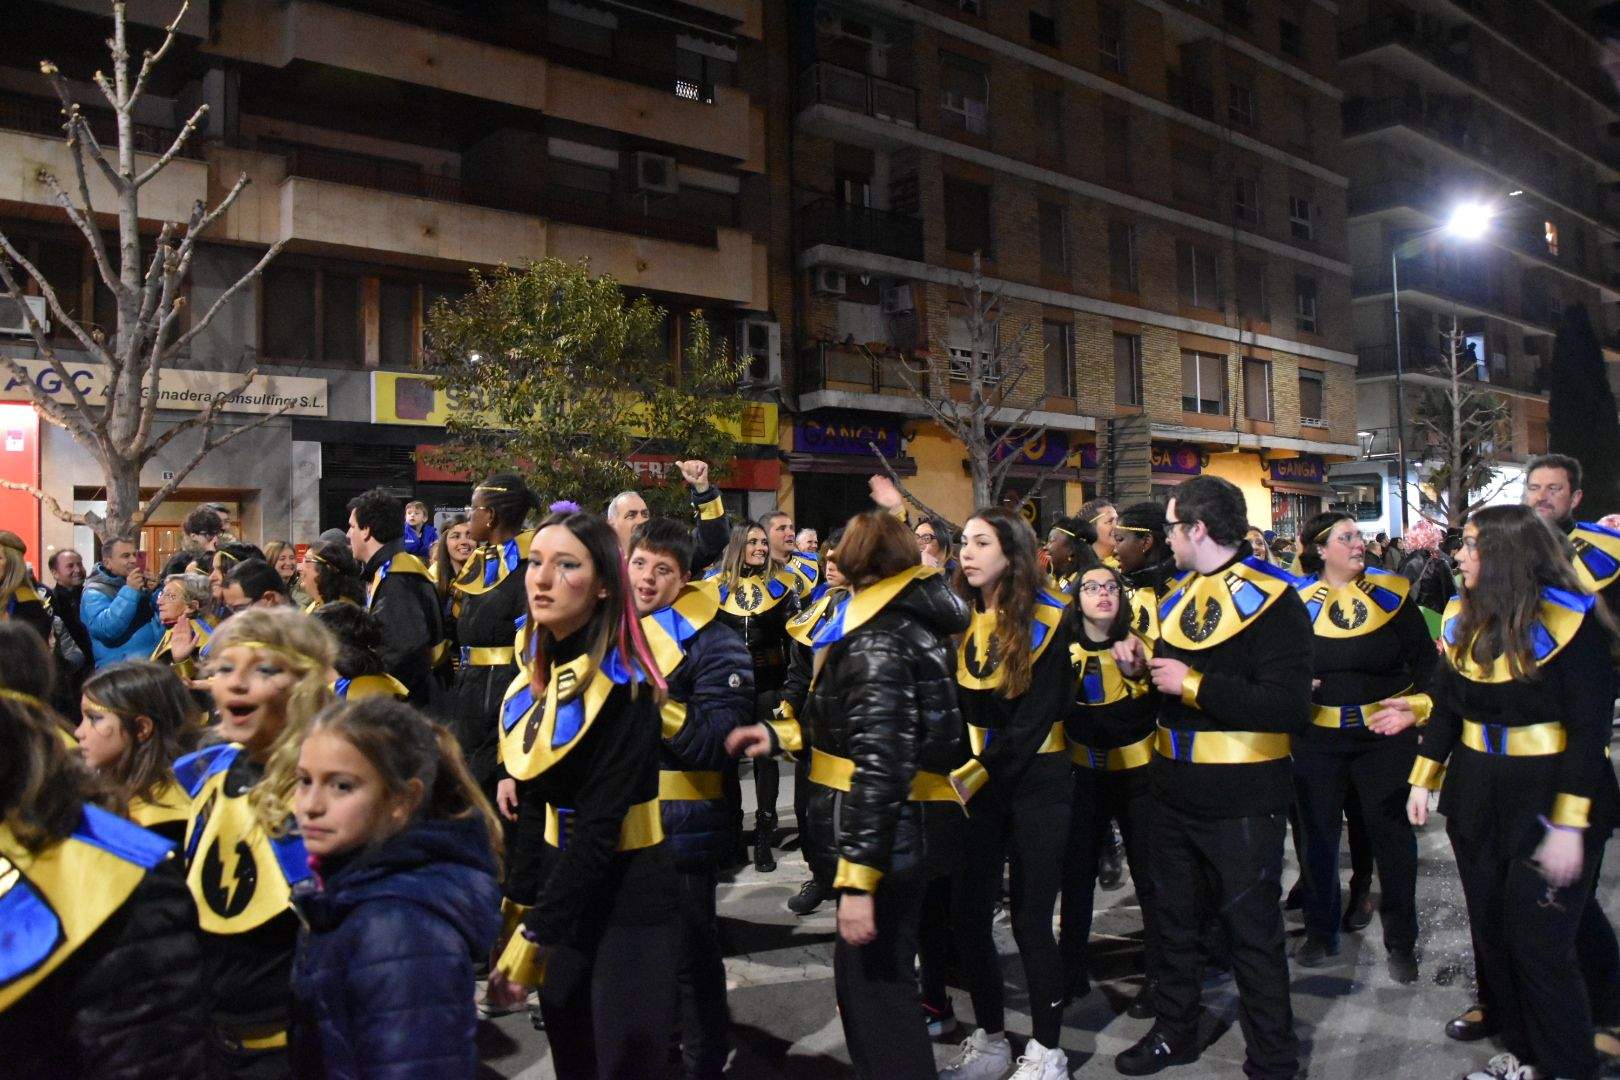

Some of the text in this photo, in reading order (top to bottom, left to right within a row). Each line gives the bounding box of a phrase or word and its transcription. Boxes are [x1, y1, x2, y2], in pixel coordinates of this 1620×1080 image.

[4, 366, 94, 396] AGC
[141, 387, 211, 402] Gnadera
[300, 396, 325, 408] S.L.
[1277, 460, 1317, 477] GANGA
